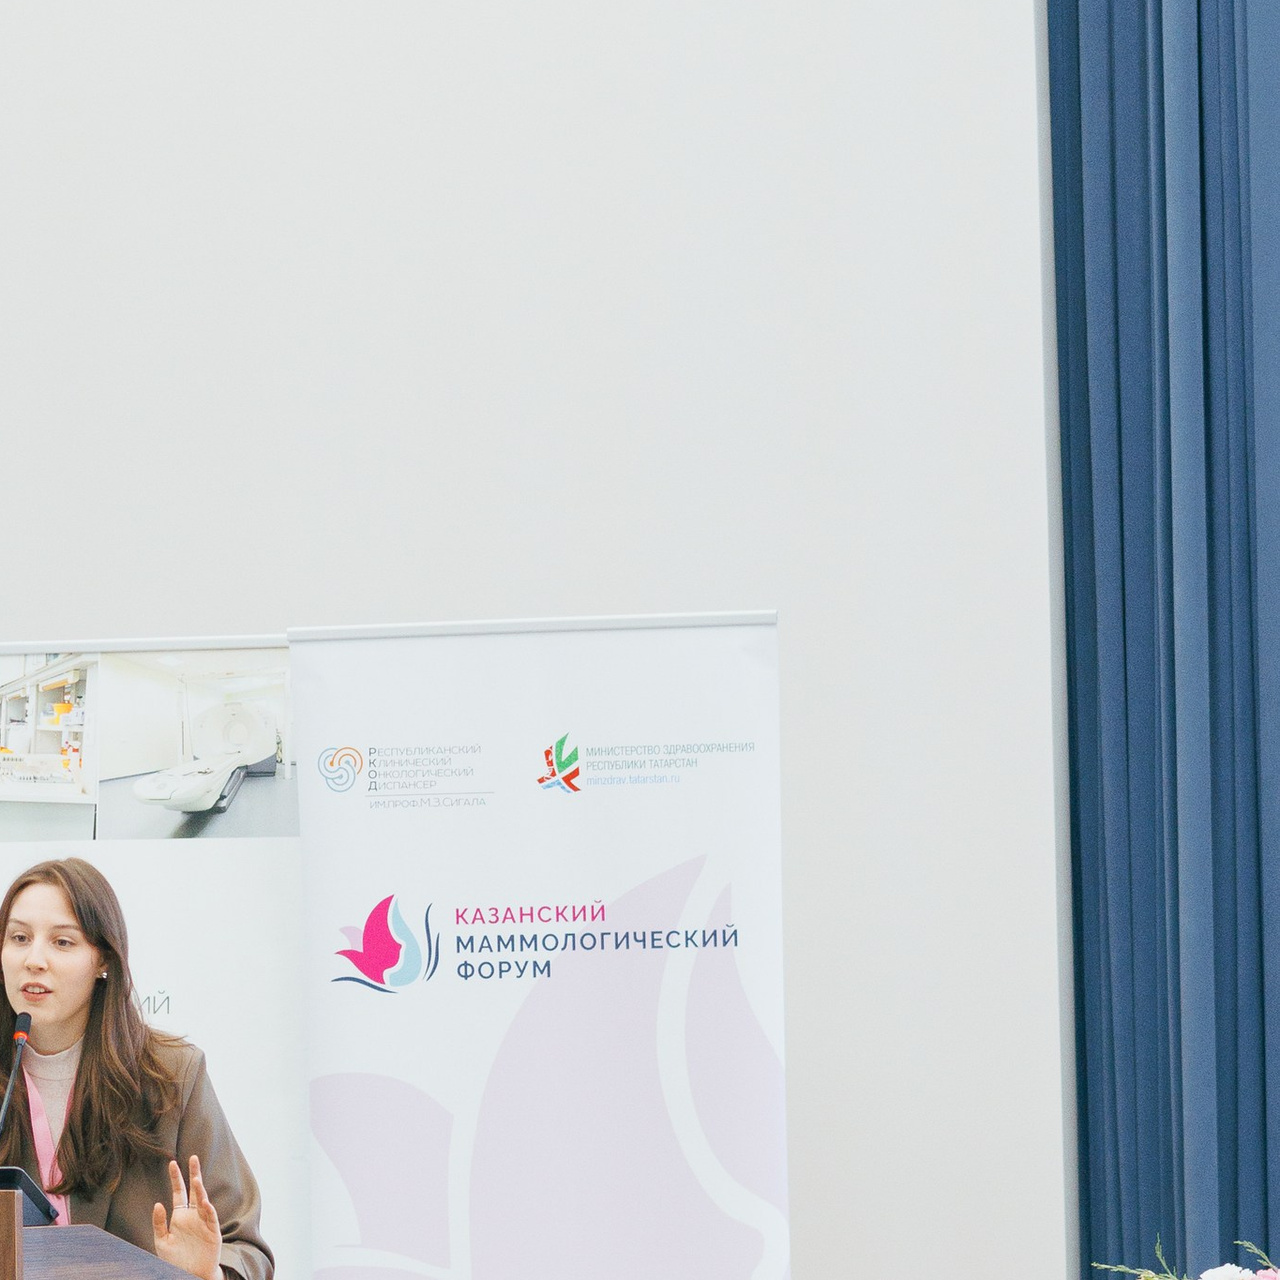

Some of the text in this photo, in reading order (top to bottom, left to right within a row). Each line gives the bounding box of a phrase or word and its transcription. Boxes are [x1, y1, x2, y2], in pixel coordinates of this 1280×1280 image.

[585, 741, 756, 757] МИНИСТЕРСТВО ЗДРАВООХРАНЕНИЯ
[585, 757, 699, 771] РЕСПУБЛИКИ ТАТАРСТАН
[367, 780, 437, 792] ДИСПАНСЕР
[585, 773, 681, 786] minzdrav.tatarstan.ru
[455, 899, 606, 926] КАЗАНСКИЙ
[455, 923, 739, 954] МАММОЛОГИЧЕСКИЙ
[456, 959, 552, 981] ФОРУМ
